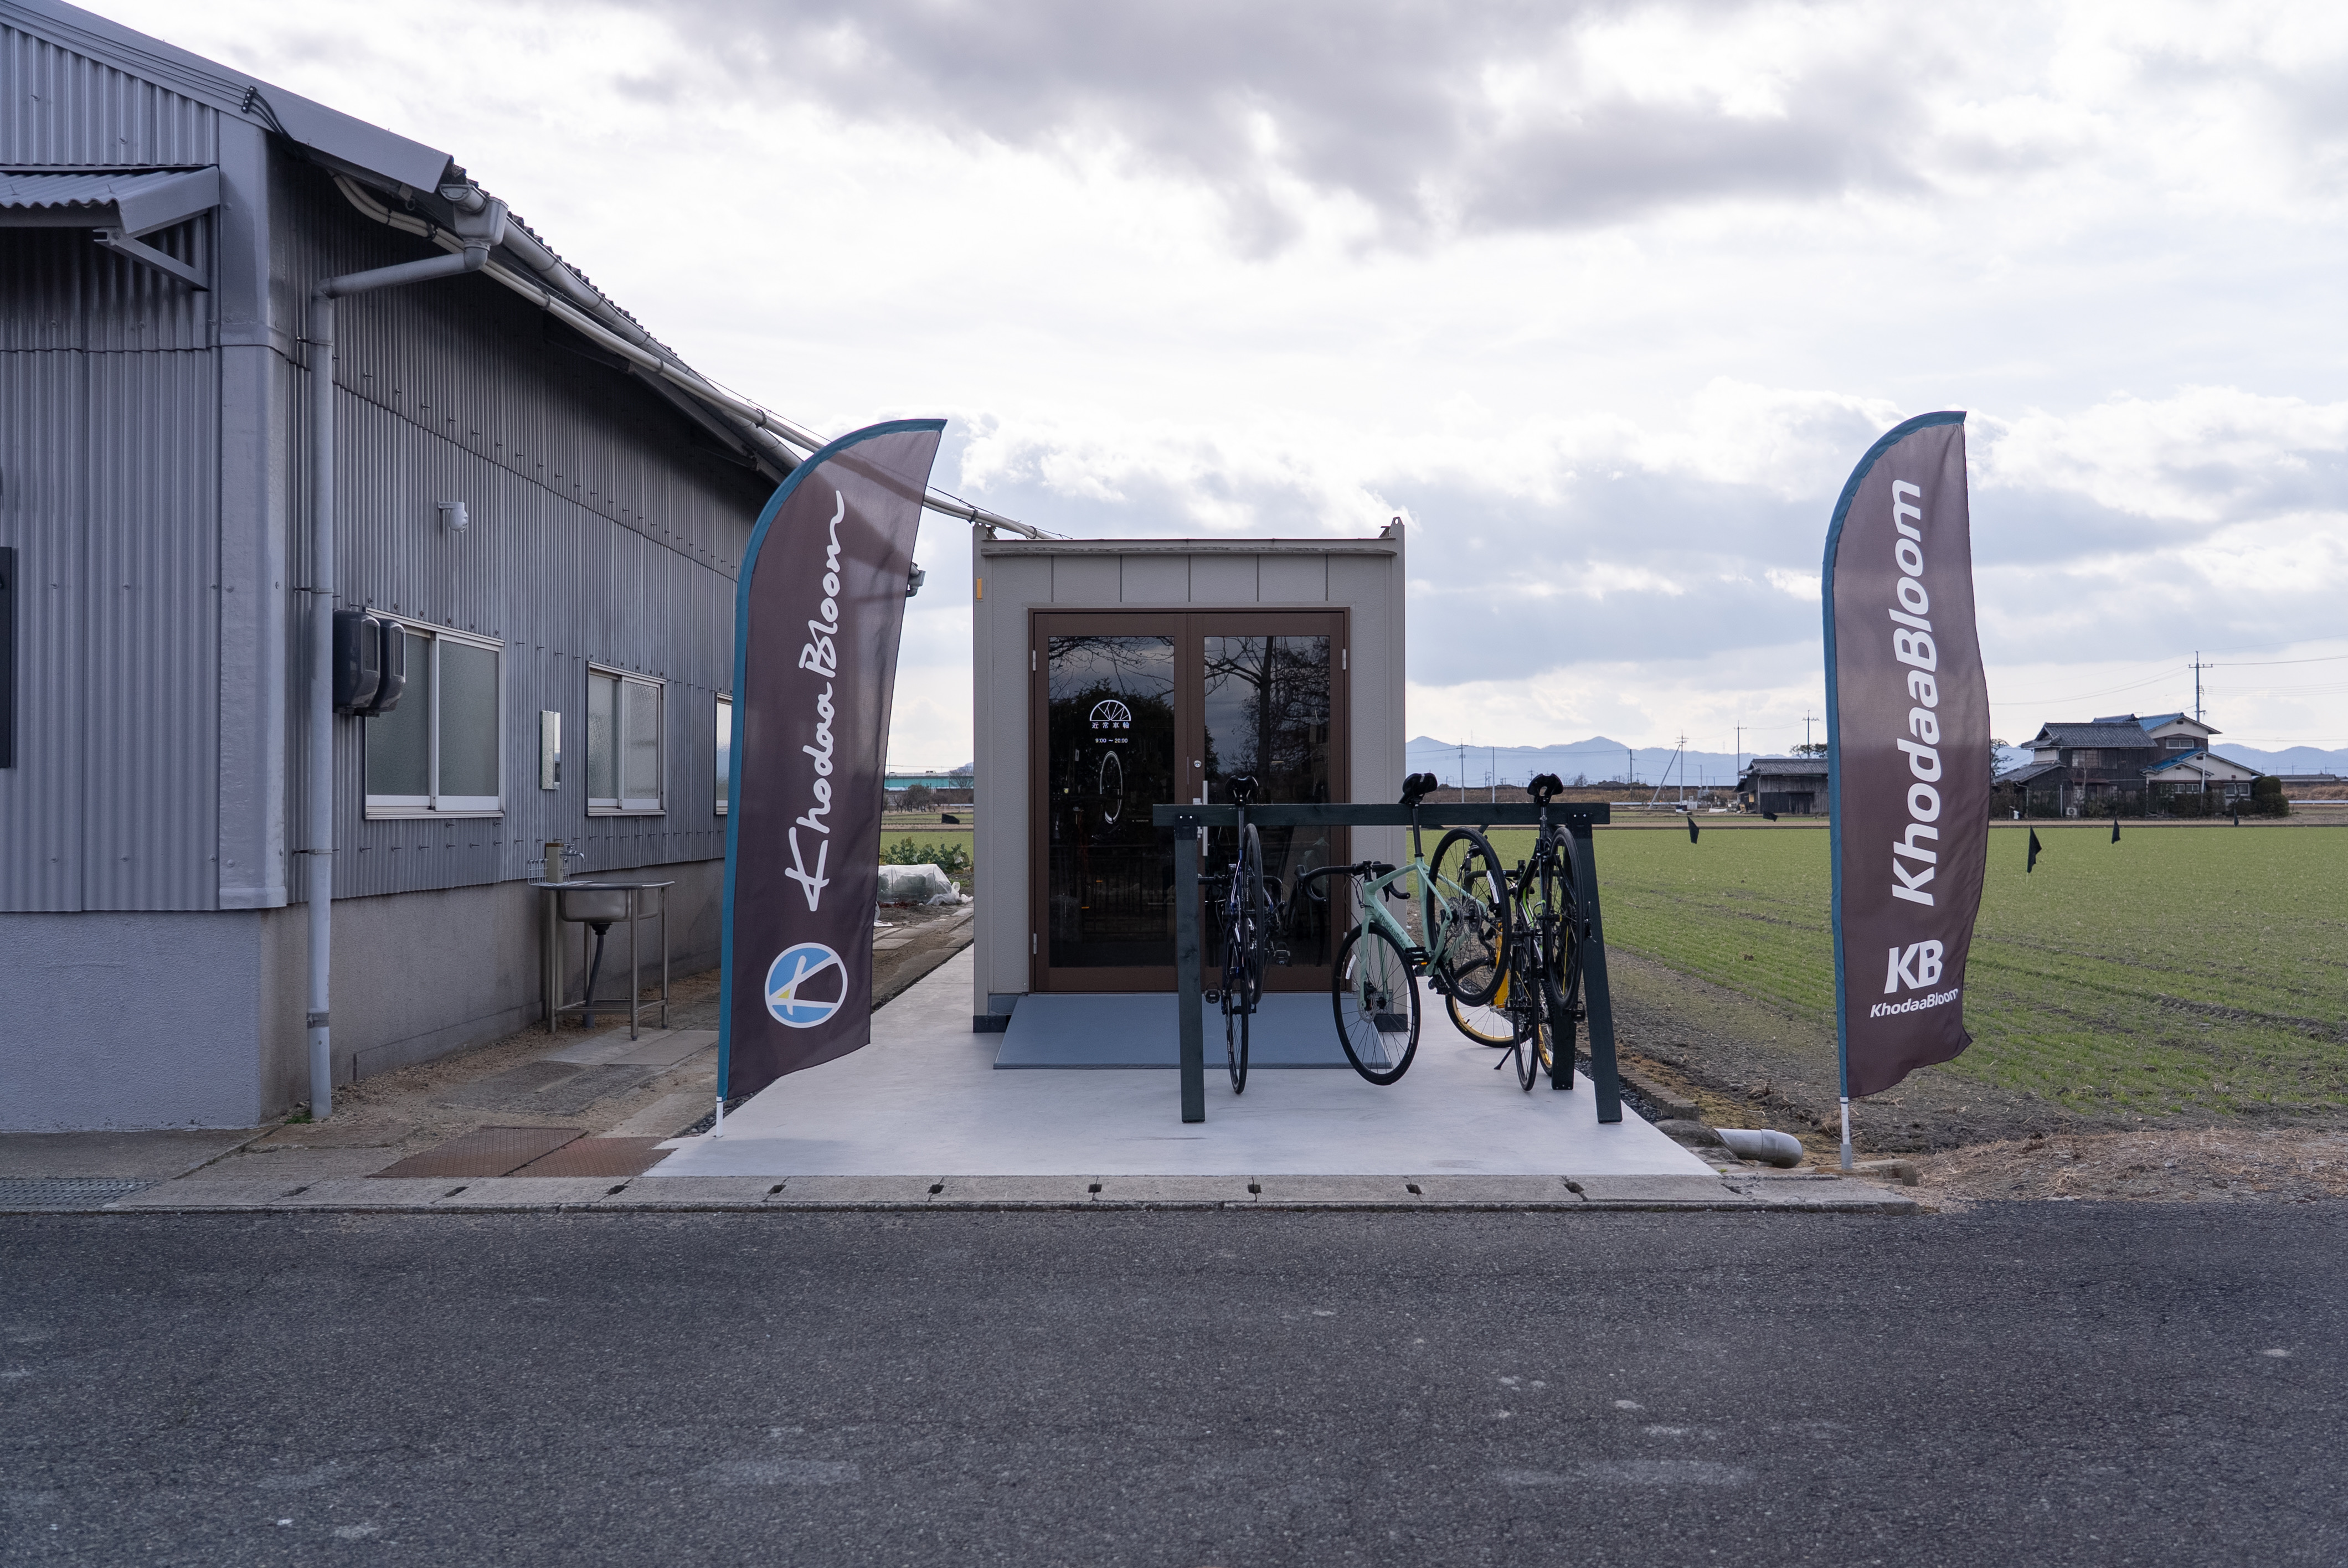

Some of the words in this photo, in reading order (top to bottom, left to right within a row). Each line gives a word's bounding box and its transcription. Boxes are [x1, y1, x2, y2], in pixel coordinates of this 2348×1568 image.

[1888, 479, 1941, 906] KhodaaBloom
[1378, 912, 1406, 951] KhodaaBloo
[1884, 940, 1943, 994] KB
[1870, 988, 1959, 1018] KhodaaBloom
